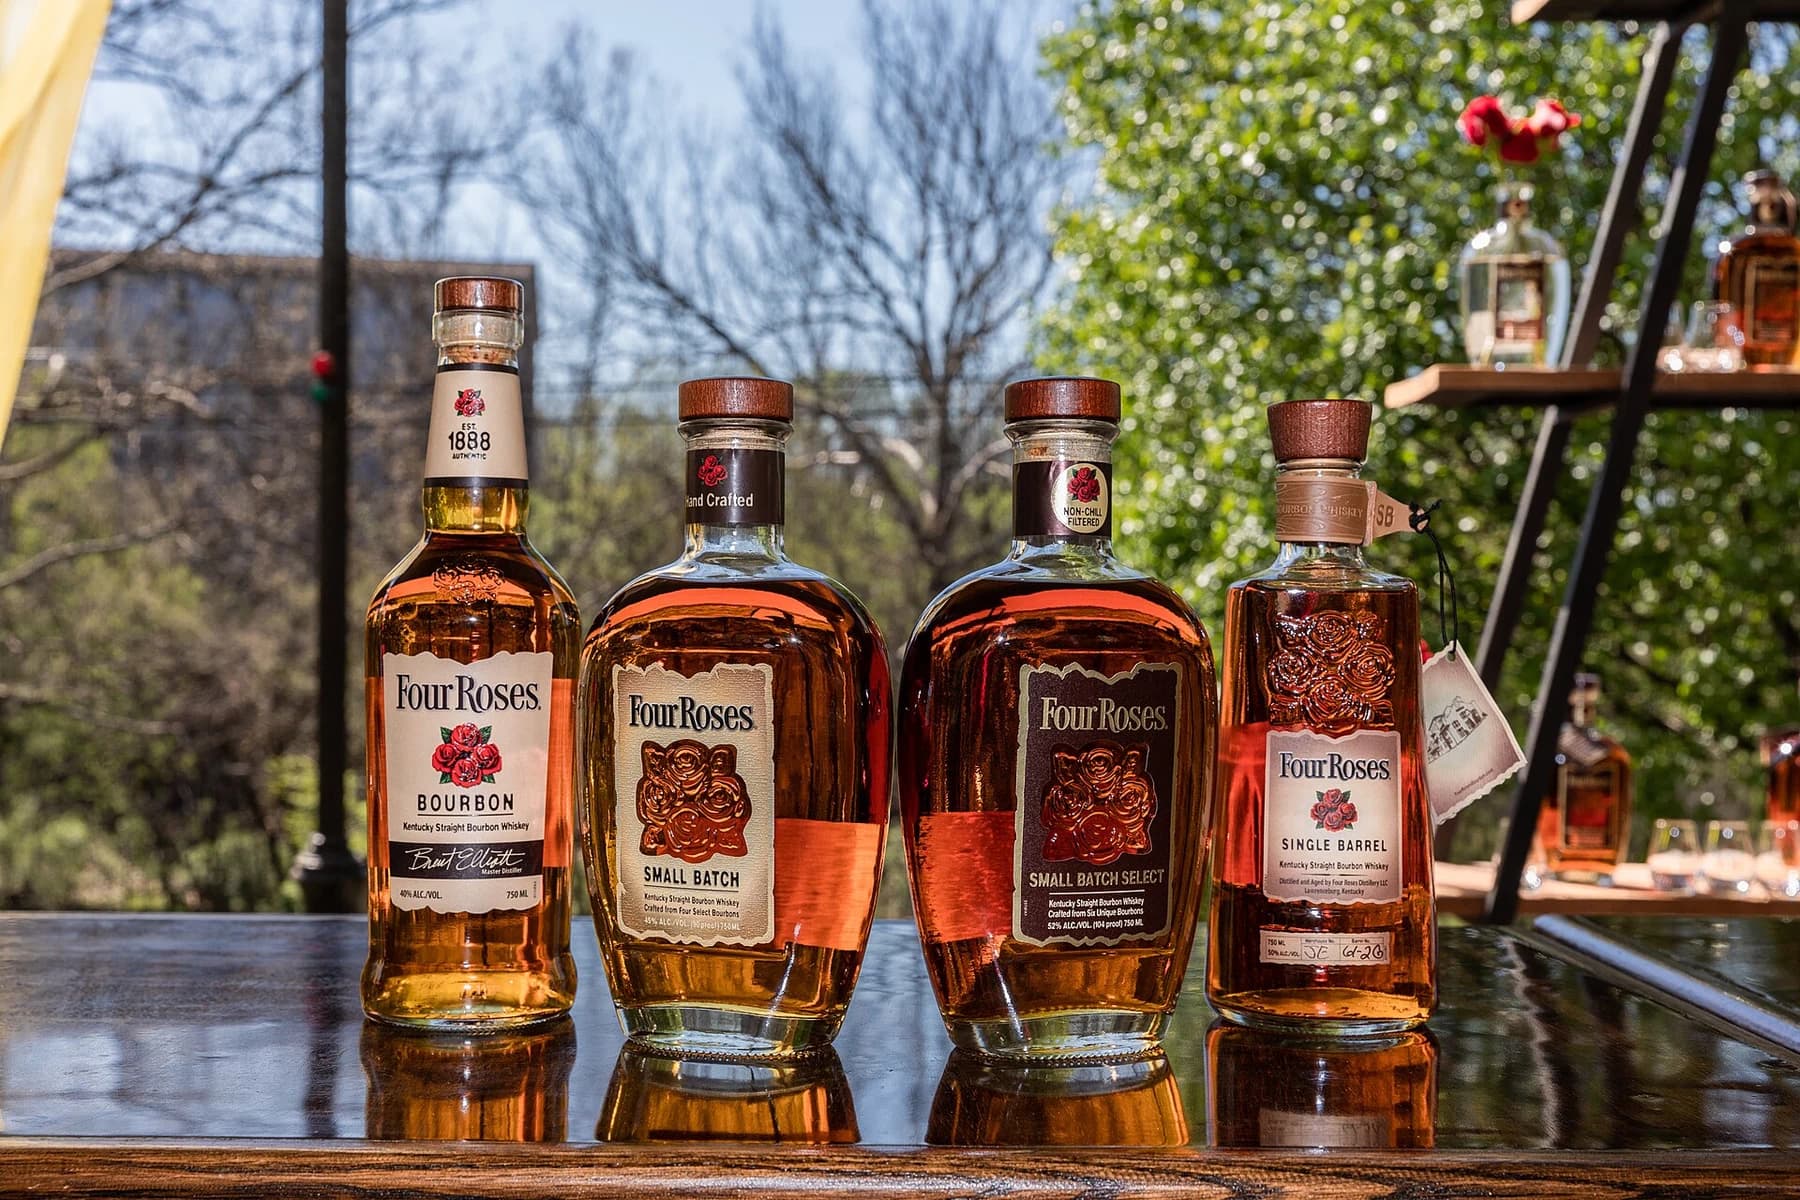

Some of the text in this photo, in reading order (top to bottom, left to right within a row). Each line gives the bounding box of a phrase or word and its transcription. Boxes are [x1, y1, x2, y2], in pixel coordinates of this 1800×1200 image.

[448, 430, 491, 451] 1888
[686, 492, 754, 508] and Crafted
[1063, 506, 1103, 517] NON-CHILL
[1376, 504, 1395, 528] SB
[1067, 517, 1100, 527] FILTERED
[396, 674, 454, 710] Four
[628, 694, 754, 732] Four Roses
[1039, 696, 1098, 731] Four
[1279, 752, 1327, 779] Four
[417, 793, 514, 812] BOURBON
[403, 821, 530, 834] Kentucky Straight Bourbon Whiskey
[1281, 838, 1388, 852] SINGLE BARREL
[1279, 860, 1390, 872] Kentucky Straight Bourbon Whiskey
[643, 866, 740, 888] SMALL BATCH
[1029, 868, 1165, 888] SMALL BATCH SELECT
[400, 889, 412, 897] 40%
[506, 890, 519, 899] 750
[519, 889, 529, 898] ML
[644, 893, 740, 908] Kentucky Straight Bourbon Whiskey
[643, 903, 740, 918] Crafted from Four Select Bourbons
[1048, 897, 1145, 909] Kentucky Straight Bourbon Whiskey
[1048, 907, 1144, 918] Crafted from Six Unique Bourbons
[1047, 921, 1062, 931] 52%
[1093, 920, 1105, 930] (104
[1106, 920, 1123, 929] proof)
[1123, 919, 1135, 927] 750
[1135, 918, 1144, 927] ML
